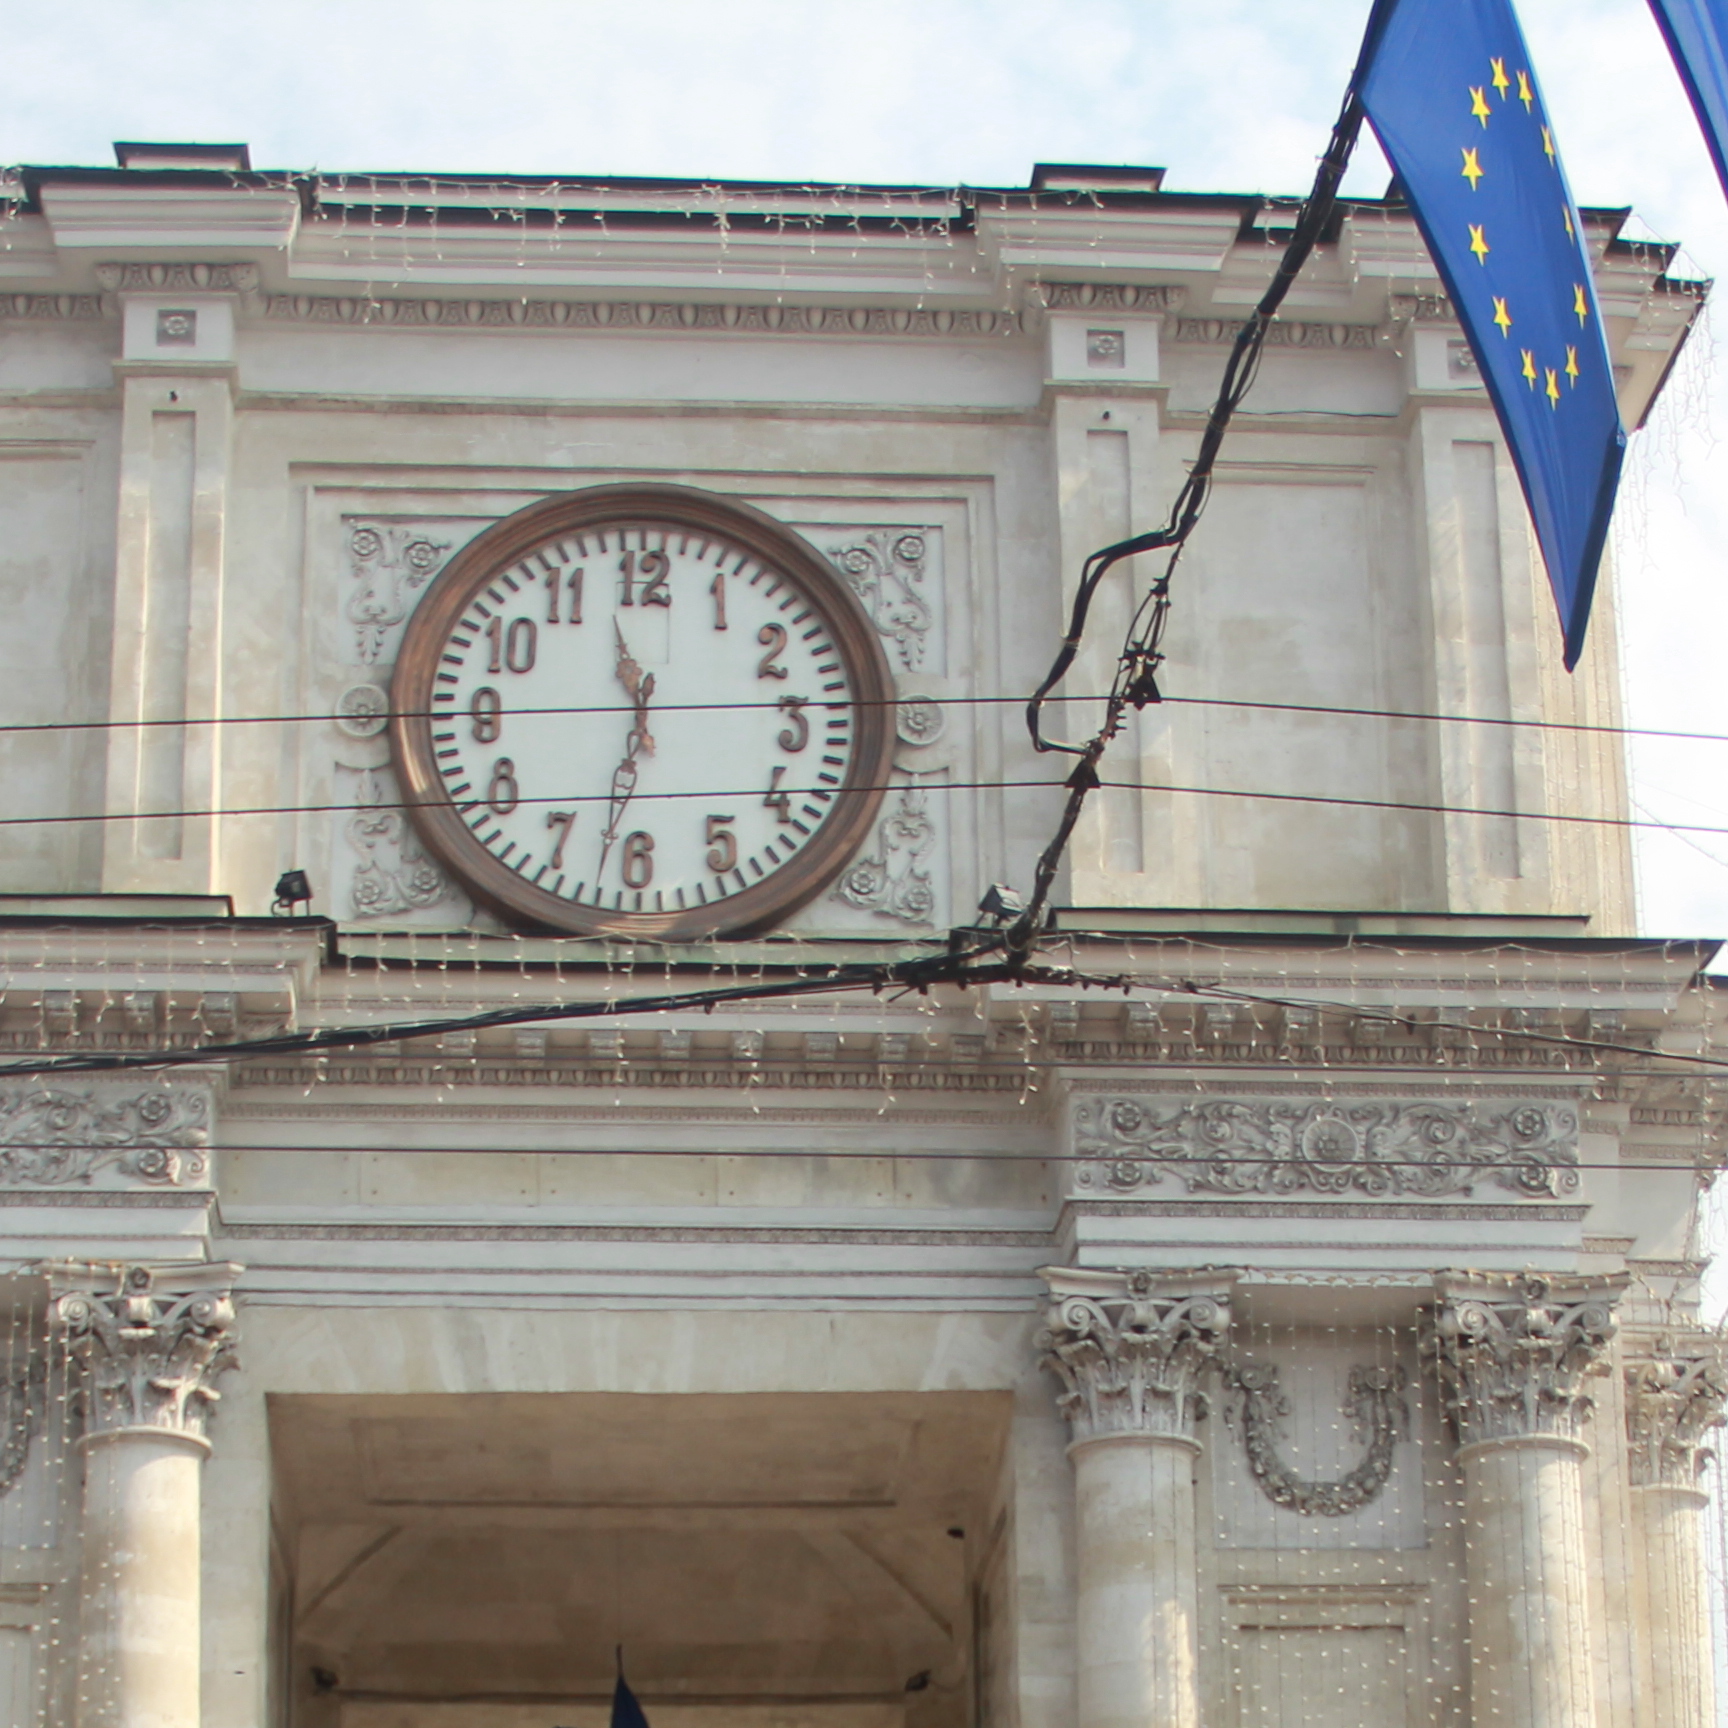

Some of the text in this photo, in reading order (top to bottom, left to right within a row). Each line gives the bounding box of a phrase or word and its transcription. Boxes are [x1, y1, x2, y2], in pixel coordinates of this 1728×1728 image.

[545, 567, 584, 624] 11
[619, 550, 671, 607] 12
[710, 573, 728, 630] 1
[485, 616, 538, 673] 10
[758, 623, 788, 680] 2
[471, 687, 502, 743] 9
[778, 695, 810, 752] 3
[488, 757, 518, 814] 8
[763, 766, 791, 823] 4
[547, 812, 577, 869] 7
[622, 831, 654, 889] 6
[706, 815, 738, 872] 5
